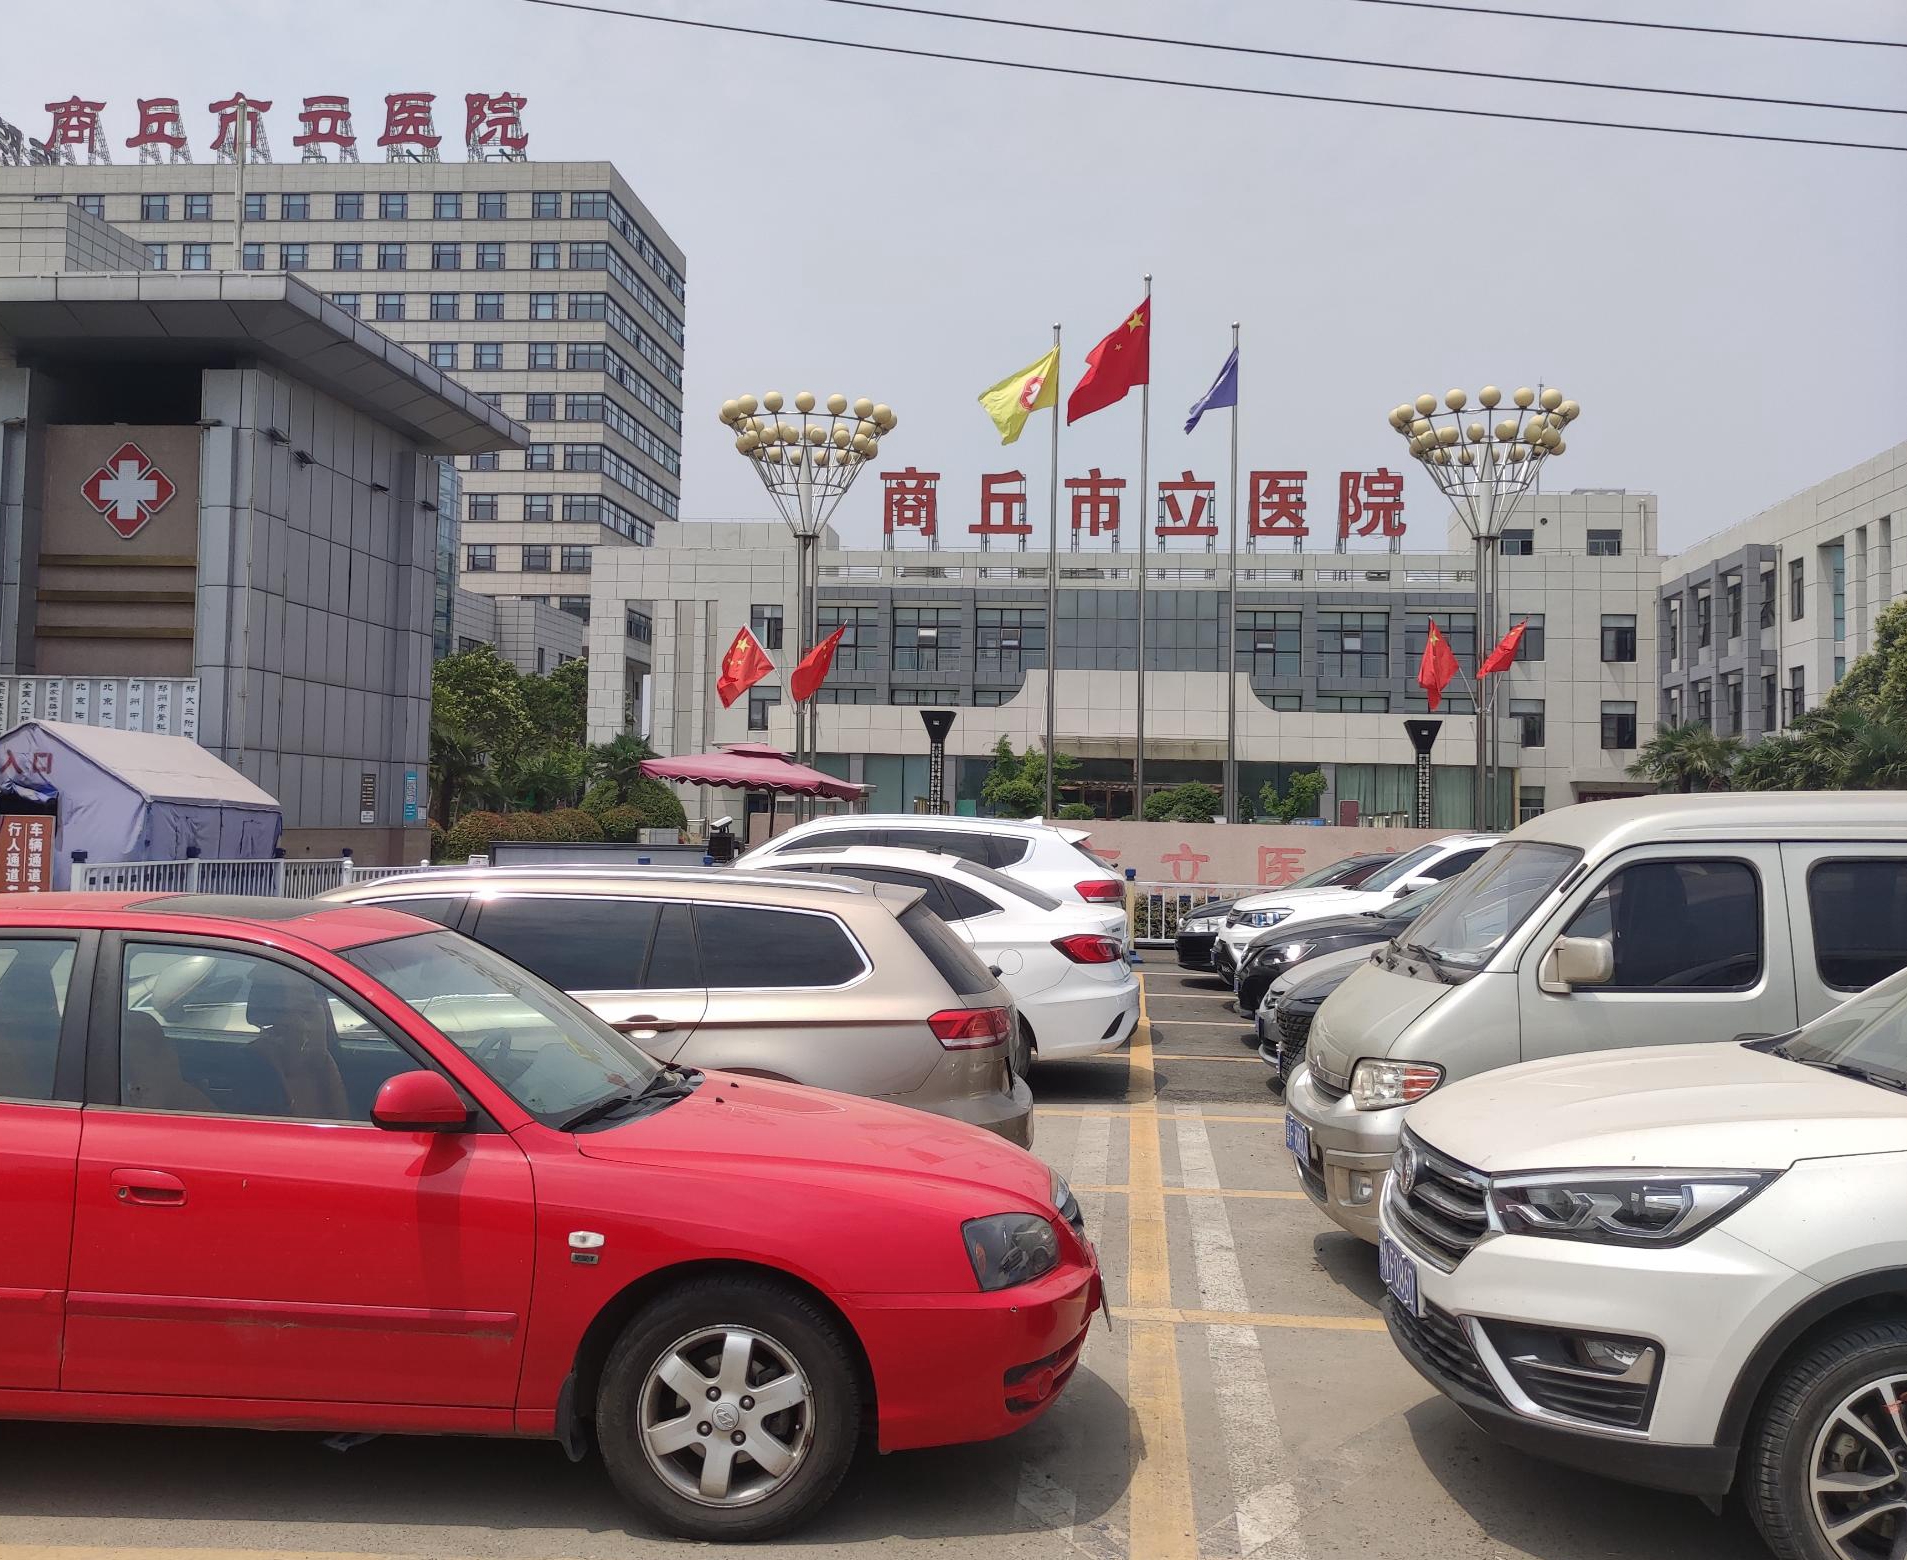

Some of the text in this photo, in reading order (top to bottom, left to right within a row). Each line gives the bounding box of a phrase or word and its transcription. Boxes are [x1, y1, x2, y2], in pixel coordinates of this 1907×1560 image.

[44, 91, 530, 153] 商丘市立医院
[880, 466, 1407, 539] 商丘市立医院
[156, 684, 168, 735] 郑州市骨科
[0, 749, 53, 774] 入口
[5, 822, 22, 882] 行人通道
[27, 822, 44, 882] 车辆通道
